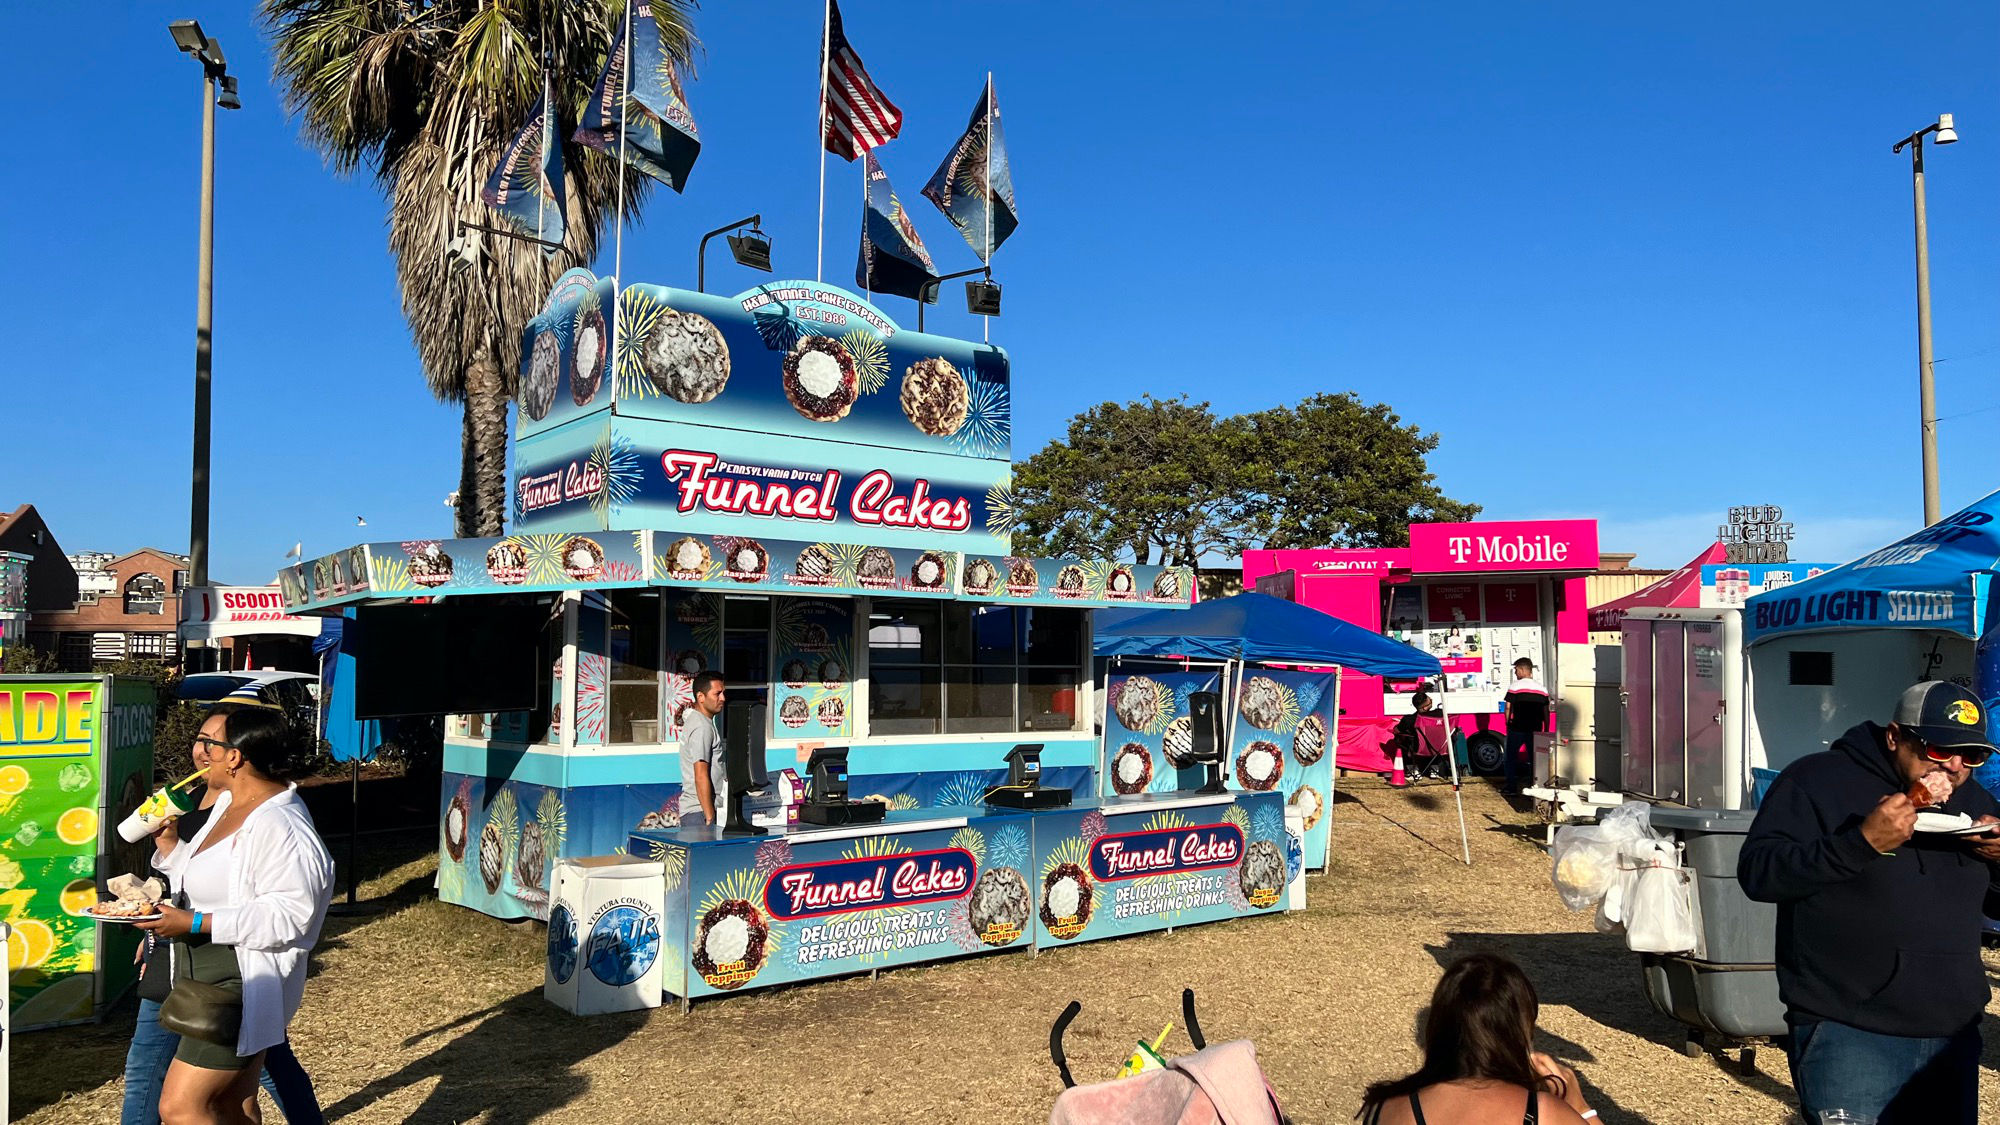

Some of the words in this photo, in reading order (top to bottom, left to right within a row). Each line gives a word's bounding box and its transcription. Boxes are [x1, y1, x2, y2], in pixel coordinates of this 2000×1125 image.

[666, 105, 688, 126] EST.
[742, 293, 769, 312] H&M
[769, 288, 813, 303] FUNNEL
[814, 290, 846, 308] CAKE
[844, 298, 895, 339] EXPRESS
[796, 306, 820, 321] EST.
[821, 309, 847, 326] 1988
[519, 468, 562, 513] Funnel
[564, 460, 604, 501] Cakes
[661, 448, 842, 525] Funnel
[849, 468, 972, 533] Cakes
[1728, 505, 1783, 525] BUD
[1718, 523, 1794, 542] LIGHT
[1477, 535, 1568, 563] Mobile
[1725, 542, 1788, 564] SELTZER
[413, 574, 450, 582] S'MORES
[671, 571, 702, 579] Apple
[723, 570, 770, 580] Raspberry
[783, 574, 817, 582] Bavarian
[856, 575, 896, 584] Powdered
[1763, 571, 1793, 581] LOUDEST
[904, 584, 950, 593] Strawberry
[1755, 598, 1801, 630] BUD
[1805, 590, 1882, 624] LIGHT
[1887, 590, 1955, 622] SELTZER
[113, 703, 153, 748] TACOS
[1102, 835, 1176, 878] Funnel
[1181, 832, 1237, 866] Cakes
[782, 864, 885, 914] Funnel
[891, 857, 968, 897] Cakes
[1115, 880, 1173, 904] DELICIOUS
[1175, 876, 1214, 899] TREATS
[1214, 875, 1223, 892] &
[1254, 887, 1274, 897] Sugar
[1113, 896, 1183, 920] REFRESHING
[1185, 889, 1226, 911] DRINKS
[1249, 894, 1280, 906] Toppings
[587, 899, 619, 926] VENTURA
[620, 896, 654, 913] COUNTY
[1058, 916, 1077, 926] Fruit
[801, 917, 879, 944] DELICIOUS
[882, 911, 933, 934] TREATS
[935, 909, 947, 926] &
[981, 929, 1021, 943] Toppings
[988, 921, 1014, 932] Sugar
[1049, 923, 1087, 936] Toppings
[797, 936, 893, 965] REFRESHING
[896, 926, 951, 953] DRINKS
[717, 960, 746, 974] Fruit
[704, 970, 757, 986] Toppings
